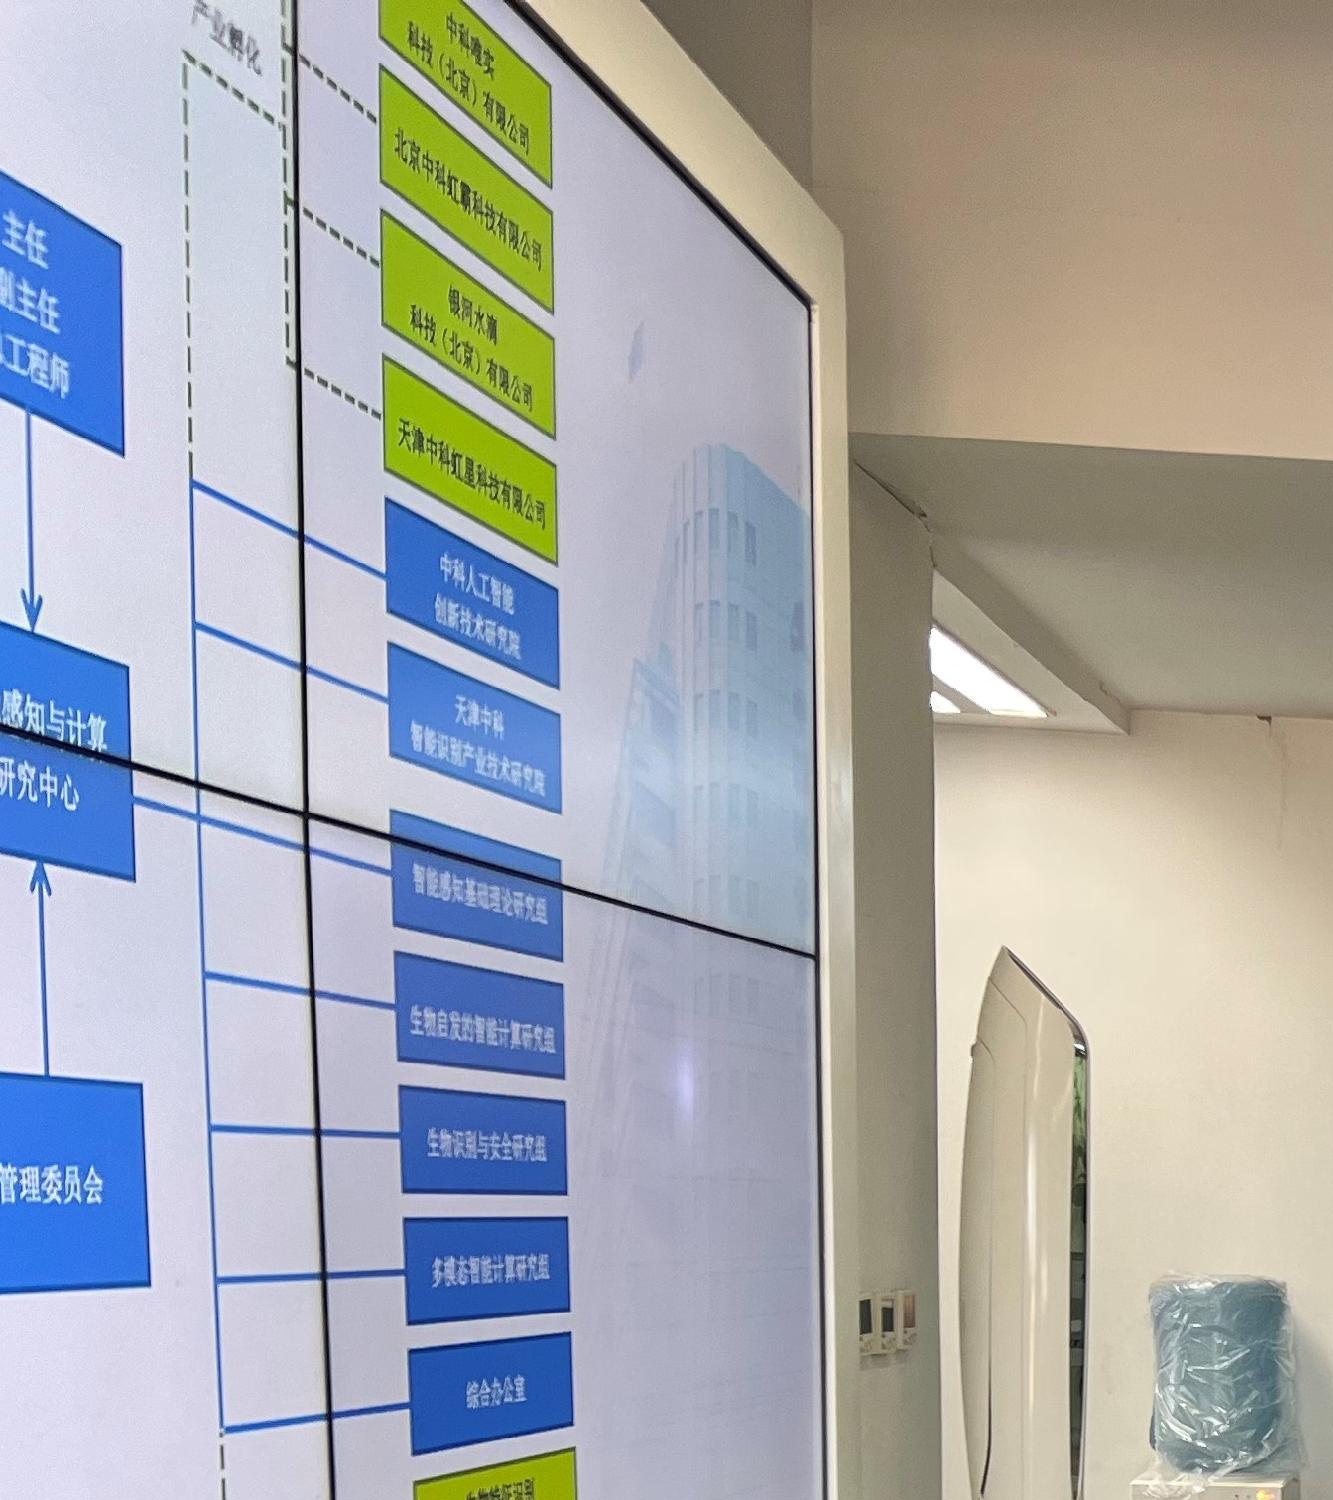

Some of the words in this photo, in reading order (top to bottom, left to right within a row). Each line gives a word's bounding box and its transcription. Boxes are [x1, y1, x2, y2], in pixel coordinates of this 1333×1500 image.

[395, 126, 542, 272] 北京中科虹霸科技有限公司
[2, 209, 49, 269] 主任
[448, 284, 497, 346] 银河水滴
[0, 334, 71, 399] 工程师
[398, 418, 546, 530] 天津中科虹星科技有限公司
[440, 552, 515, 616] 中科人工智能
[434, 592, 521, 661] 创新技术研究院
[2, 689, 107, 752] 感知与计算
[455, 694, 505, 740] 天津中科
[0, 757, 80, 811] 研究中心
[410, 720, 546, 797] 智能识别产业技术研究院
[412, 862, 549, 925] 智能感知基础理论研究组
[410, 1004, 556, 1054] 生物启发的智能计算研究组
[427, 1127, 547, 1162] 生物识别与安全研究组
[0, 1163, 104, 1204] 管理委员会
[432, 1253, 550, 1288] 多模态智能计算研究组
[466, 1374, 527, 1410] 综合办公室
